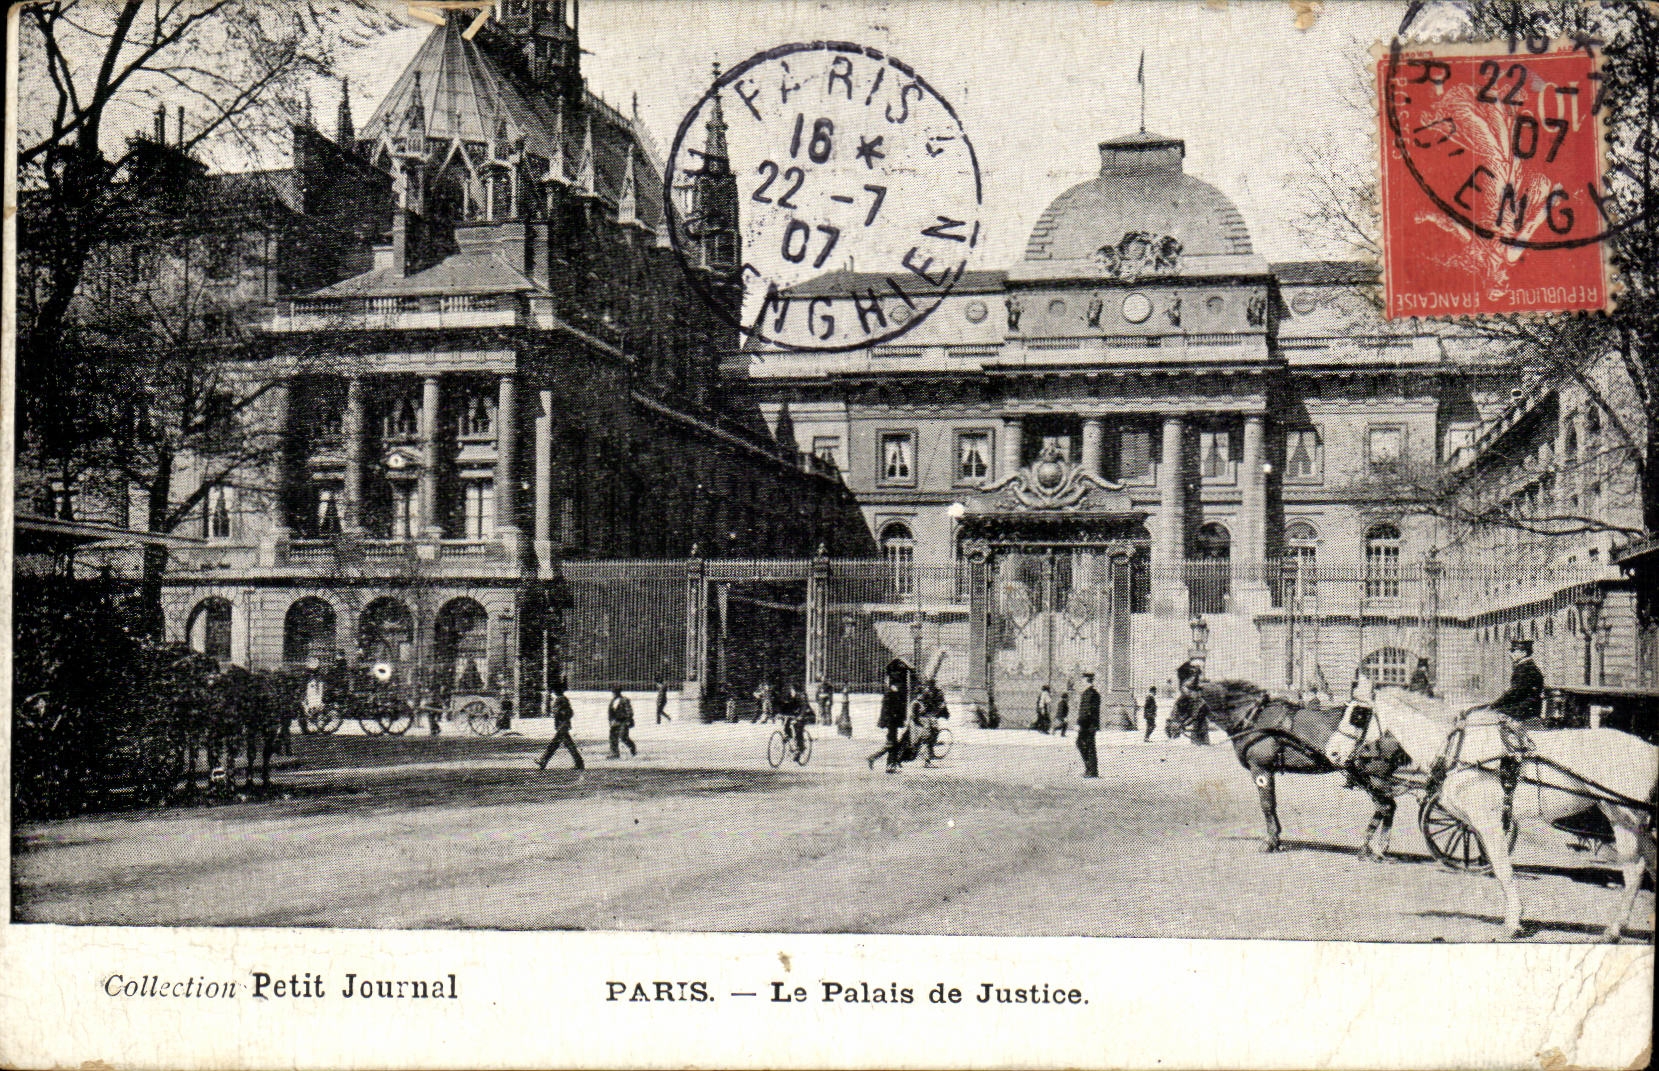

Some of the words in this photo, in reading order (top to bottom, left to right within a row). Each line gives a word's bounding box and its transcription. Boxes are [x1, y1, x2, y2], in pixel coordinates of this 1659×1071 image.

[1477, 60, 1529, 107] 22
[789, 112, 834, 164] 16
[1511, 115, 1570, 163] 07
[751, 159, 805, 210] 22
[781, 218, 841, 269] 07
